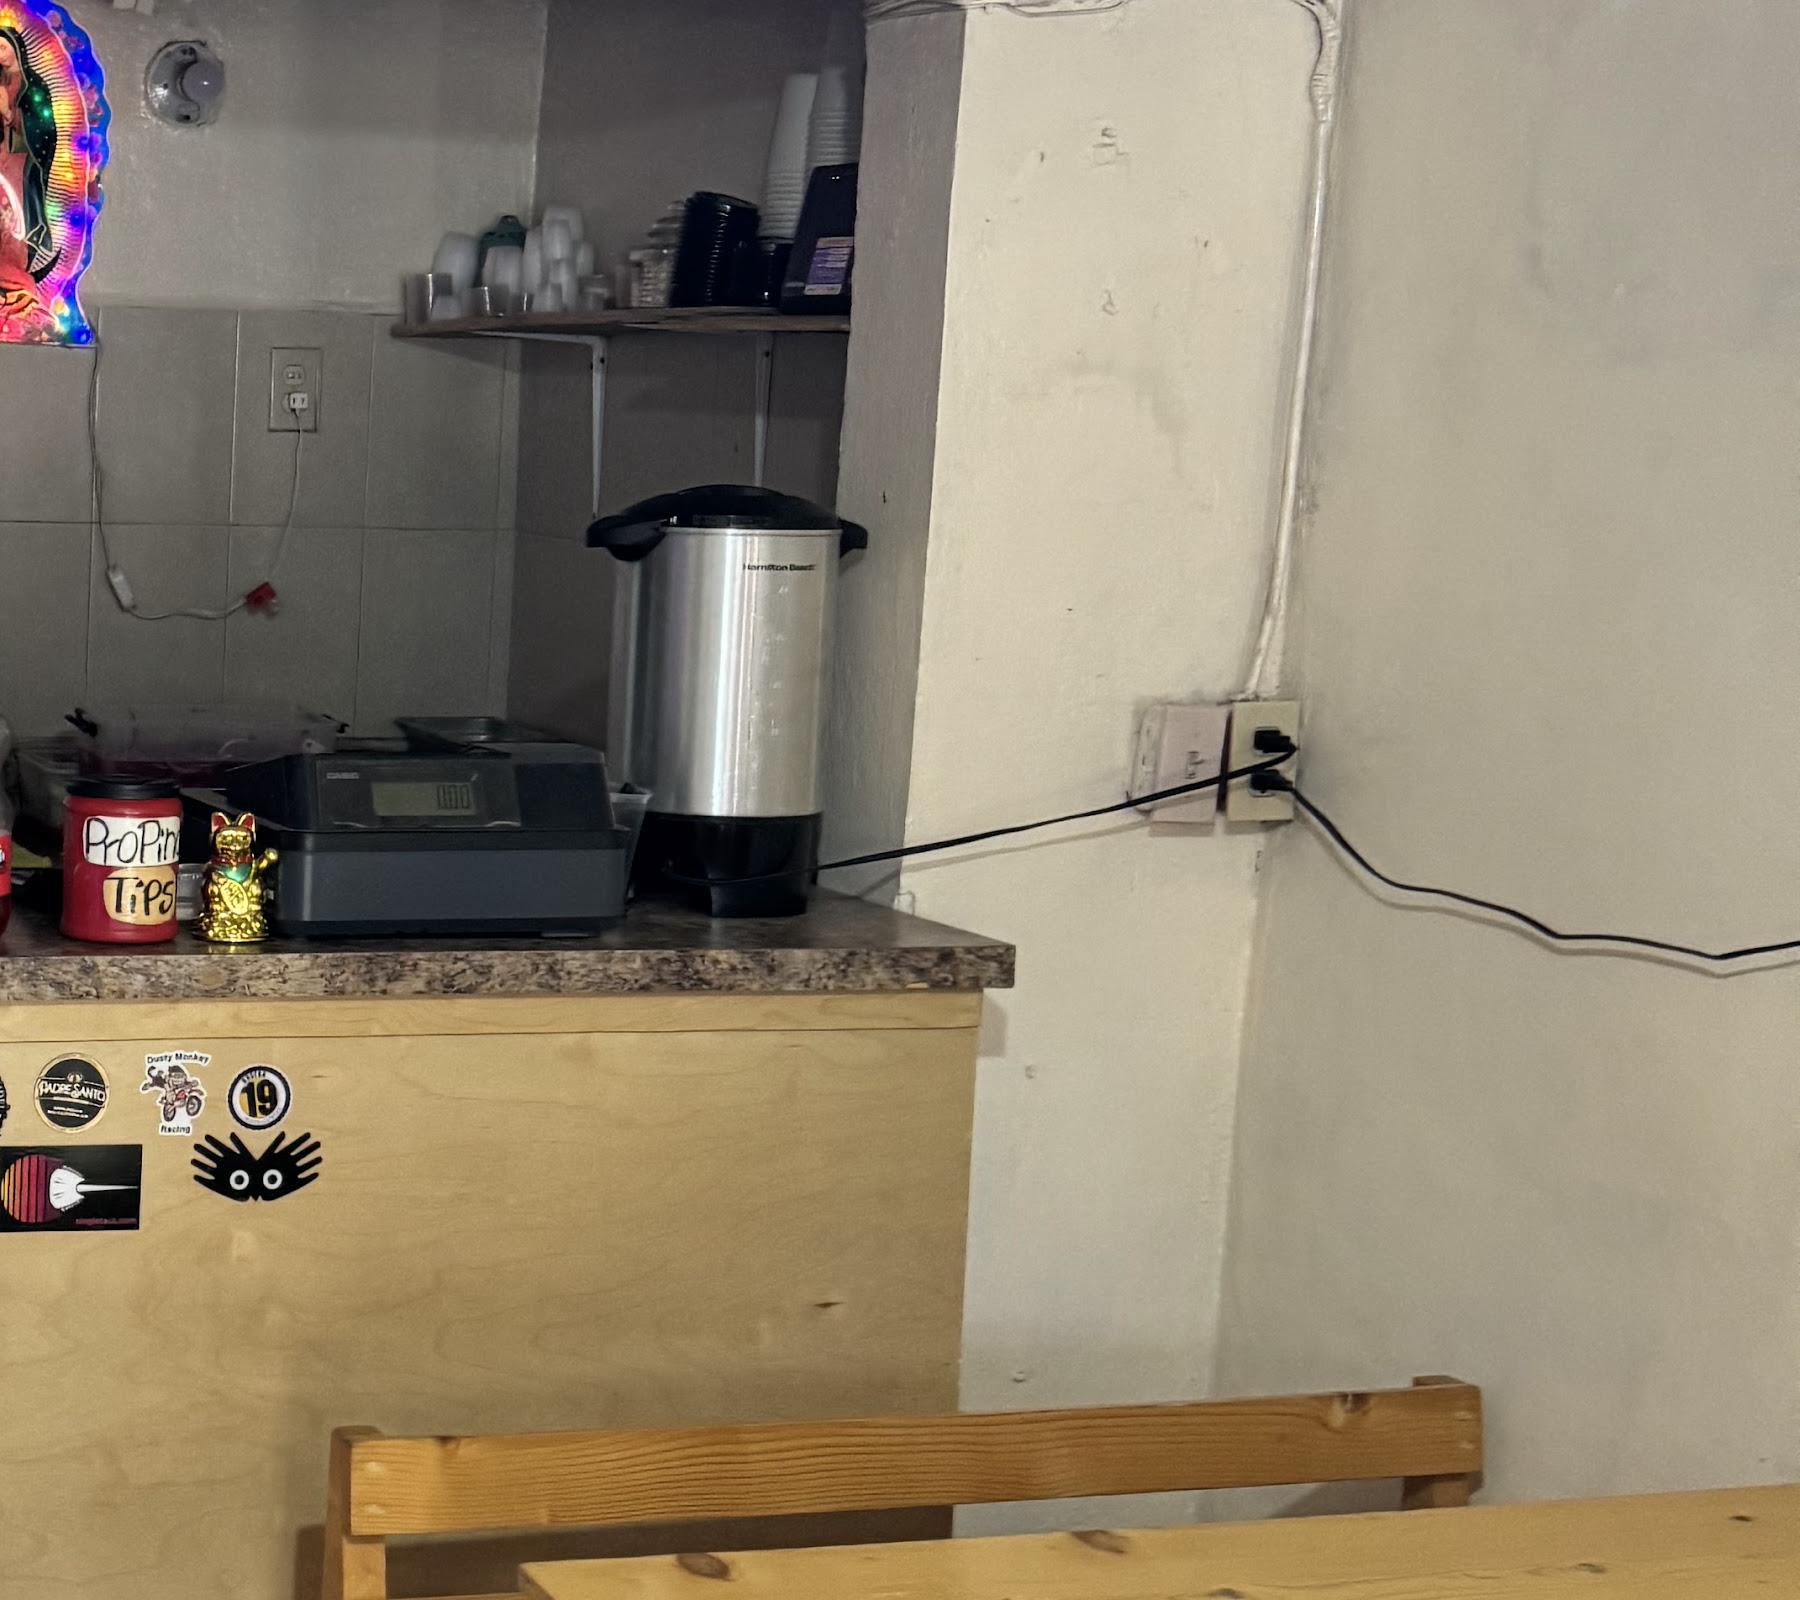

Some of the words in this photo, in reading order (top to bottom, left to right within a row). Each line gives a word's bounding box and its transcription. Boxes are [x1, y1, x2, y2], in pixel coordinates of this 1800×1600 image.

[106, 876, 175, 916] Tips
[147, 1055, 173, 1064] Dusty
[175, 1053, 209, 1064] Monkey
[39, 1080, 73, 1097] PADRE
[71, 1083, 106, 1102] SANTO
[240, 1078, 278, 1118] 19
[161, 1125, 191, 1134] Racing
